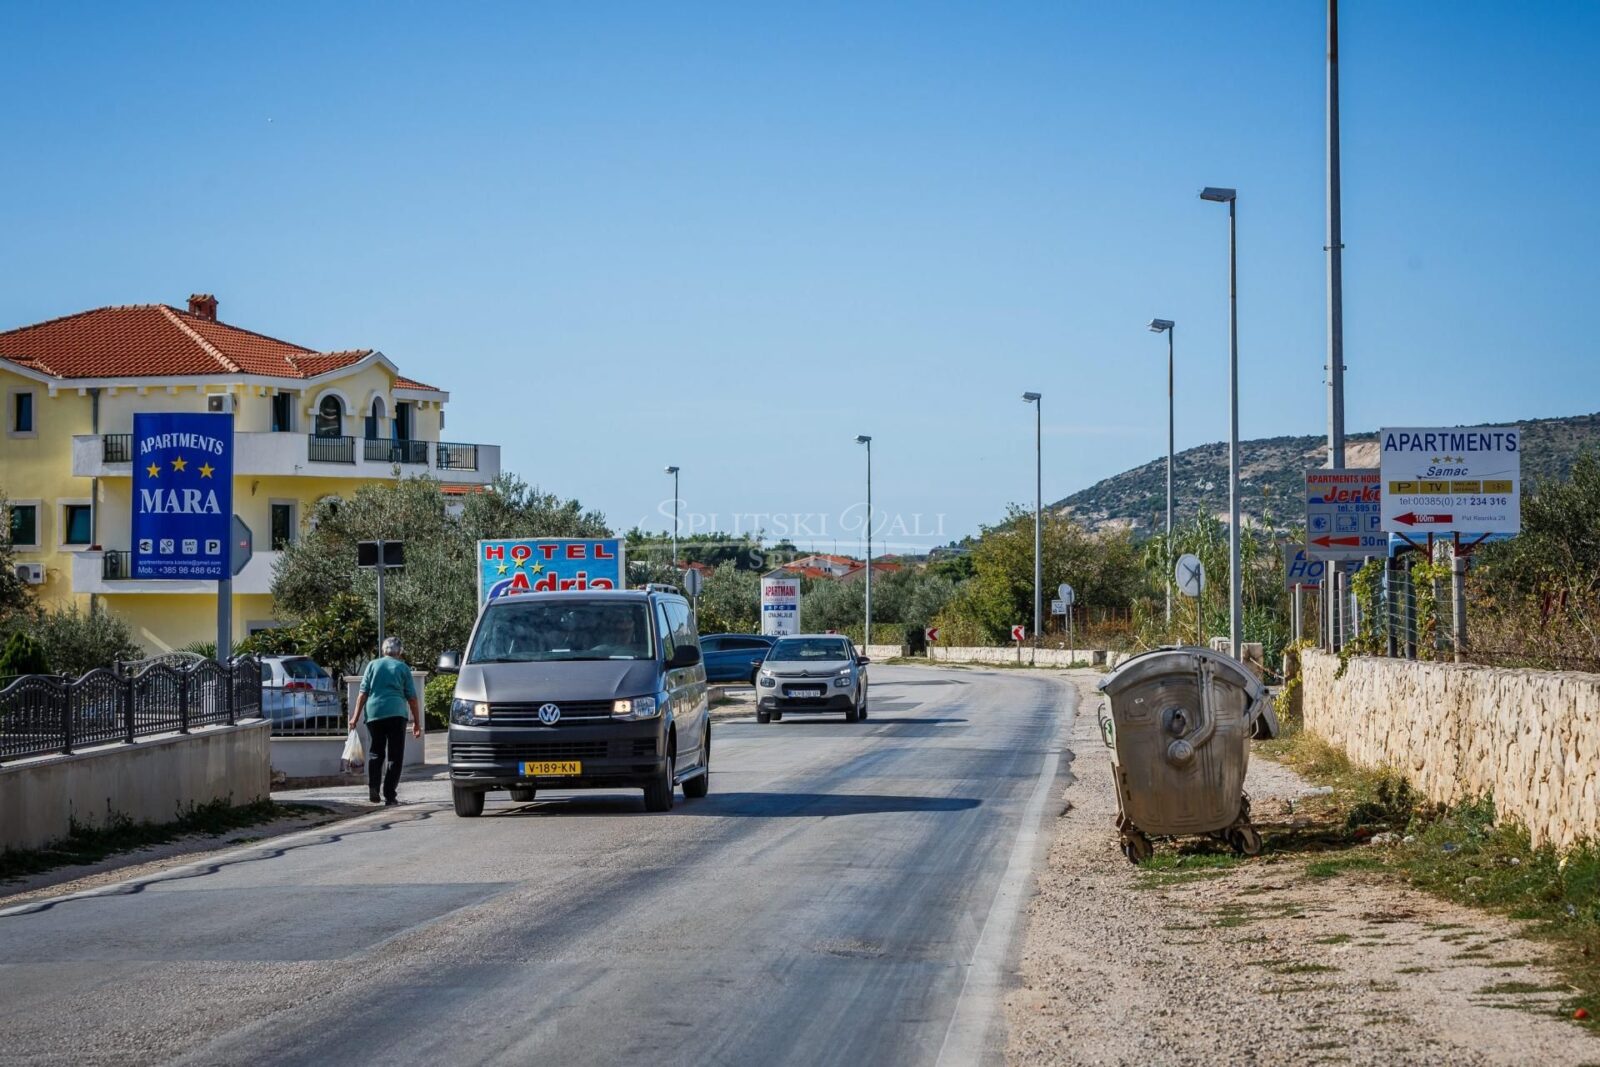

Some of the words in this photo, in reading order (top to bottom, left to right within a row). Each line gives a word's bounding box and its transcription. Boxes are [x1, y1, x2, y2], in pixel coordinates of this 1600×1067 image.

[140, 432, 224, 455] APARTMENTS
[1384, 432, 1517, 452] APARTMENTS
[1426, 466, 1469, 477] Samac
[1307, 474, 1358, 483] APARTMENTS
[1397, 482, 1412, 492] P
[1428, 483, 1442, 492] TV
[139, 488, 222, 514] MARA
[1456, 497, 1467, 506] 21
[1470, 497, 1487, 506] 234
[1489, 497, 1507, 506] 316
[485, 543, 615, 560] HOTEL
[158, 566, 177, 575] +385
[178, 566, 188, 575] 98
[190, 566, 205, 575] 488
[206, 566, 221, 575] 642
[765, 585, 796, 597] APARTMANI
[528, 762, 576, 774] V-189-KN
